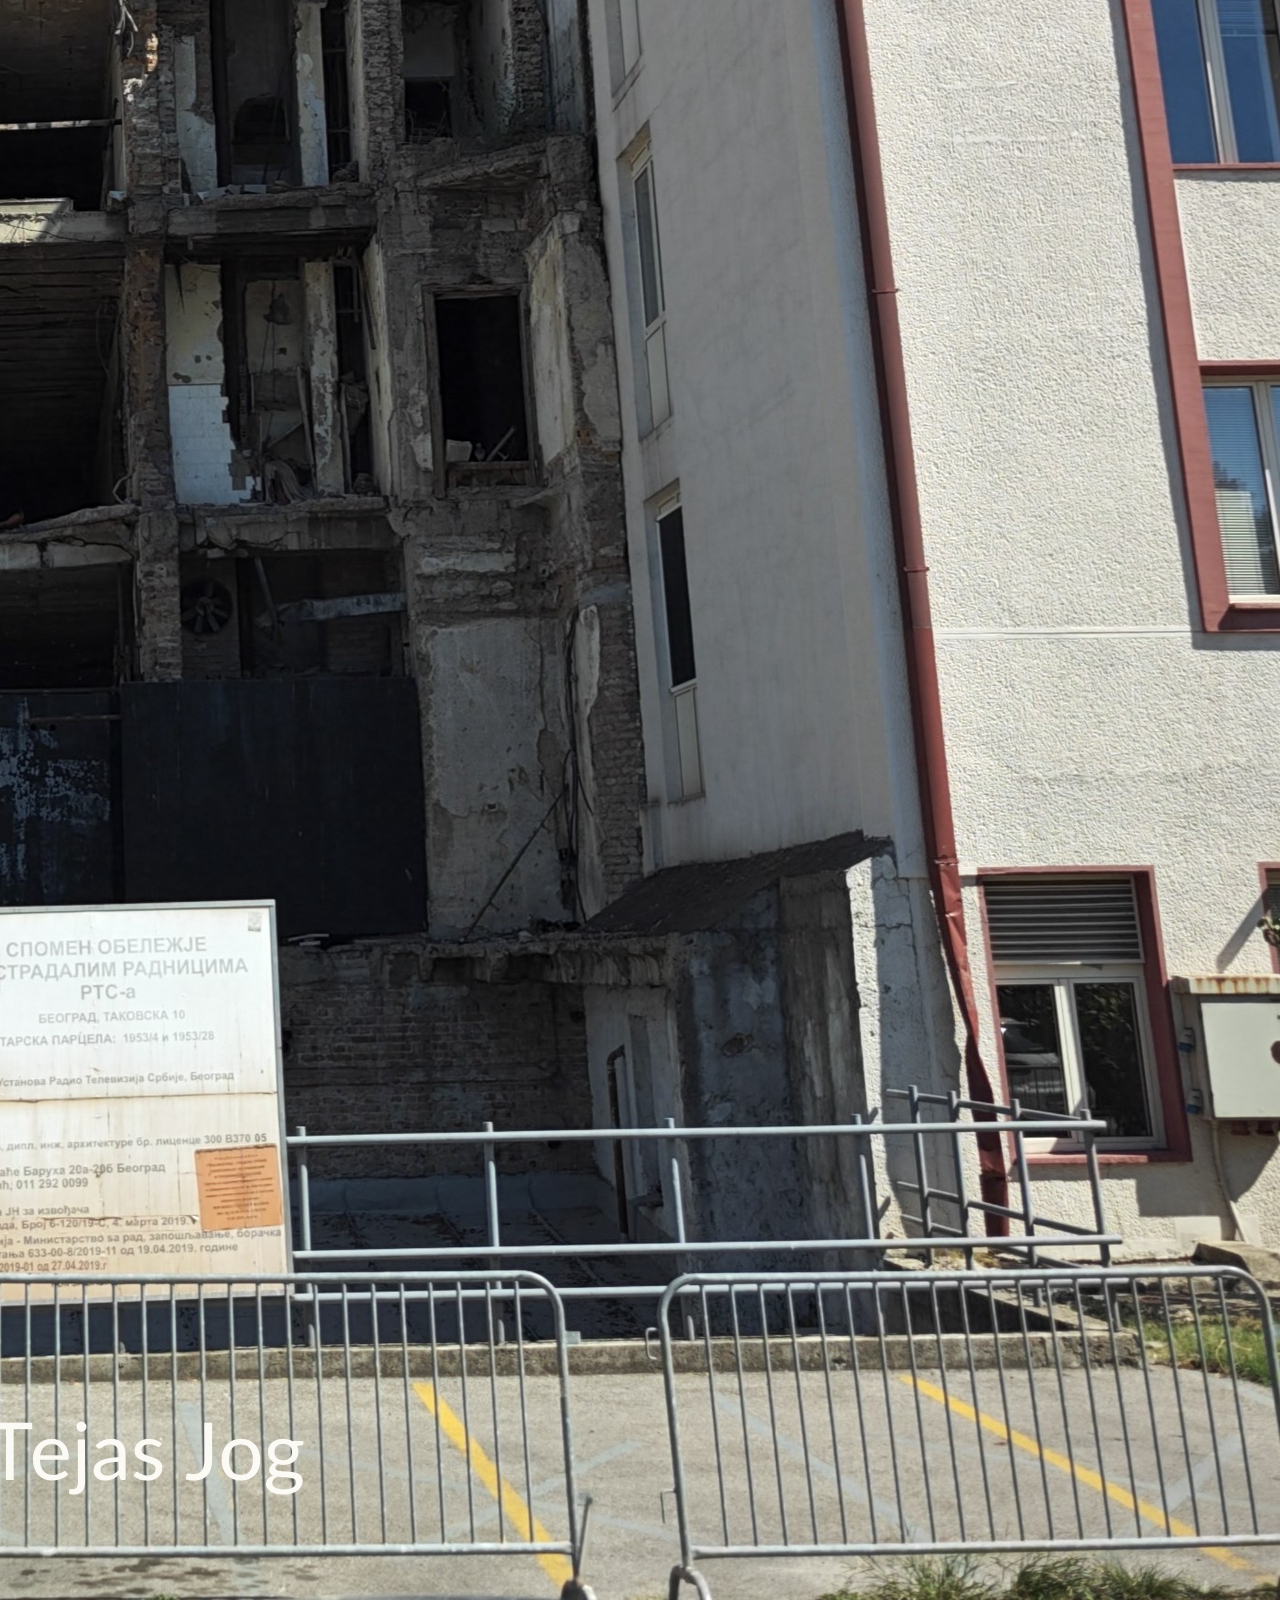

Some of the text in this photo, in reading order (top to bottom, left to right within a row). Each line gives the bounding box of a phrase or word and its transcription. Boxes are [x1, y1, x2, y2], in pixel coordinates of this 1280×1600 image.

[6, 936, 207, 957] СПОМЕН ОБЕЛЕЖЈЕ
[122, 958, 248, 978] РАДНИЦИМА
[80, 984, 136, 1000] РТС-а
[103, 1011, 168, 1022] ТАКОВСКА
[173, 1010, 185, 1020] 10
[52, 1033, 116, 1046] ПАРЦЕЛА:
[123, 1032, 159, 1044] 1953/4
[162, 1034, 169, 1042] и
[173, 1031, 215, 1042] 1953/28
[49, 1076, 82, 1086] Радио
[86, 1074, 144, 1084] Телевизија
[147, 1072, 187, 1084] Србије,
[190, 1071, 234, 1081] Београд
[67, 1138, 133, 1150] архитектуре
[136, 1137, 153, 1148] бр.
[156, 1137, 201, 1147] лиценце
[204, 1135, 221, 1144] 300
[255, 1133, 267, 1142] 05
[23, 1166, 65, 1178] Баруха
[117, 1163, 166, 1174] Београд
[17, 1180, 34, 1189] 011
[39, 1179, 59, 1188] 292
[62, 1178, 88, 1188] 0099
[5, 1207, 20, 1217] ЈН
[23, 1208, 34, 1216] за
[38, 1205, 90, 1217] извођача
[21, 1220, 46, 1231] Број
[125, 1218, 158, 1229] марта
[23, 1235, 104, 1245] Министарство
[237, 1228, 281, 1239] борачка
[120, 1248, 134, 1256] од
[200, 1243, 238, 1253] године
[37, 1263, 49, 1272] од
